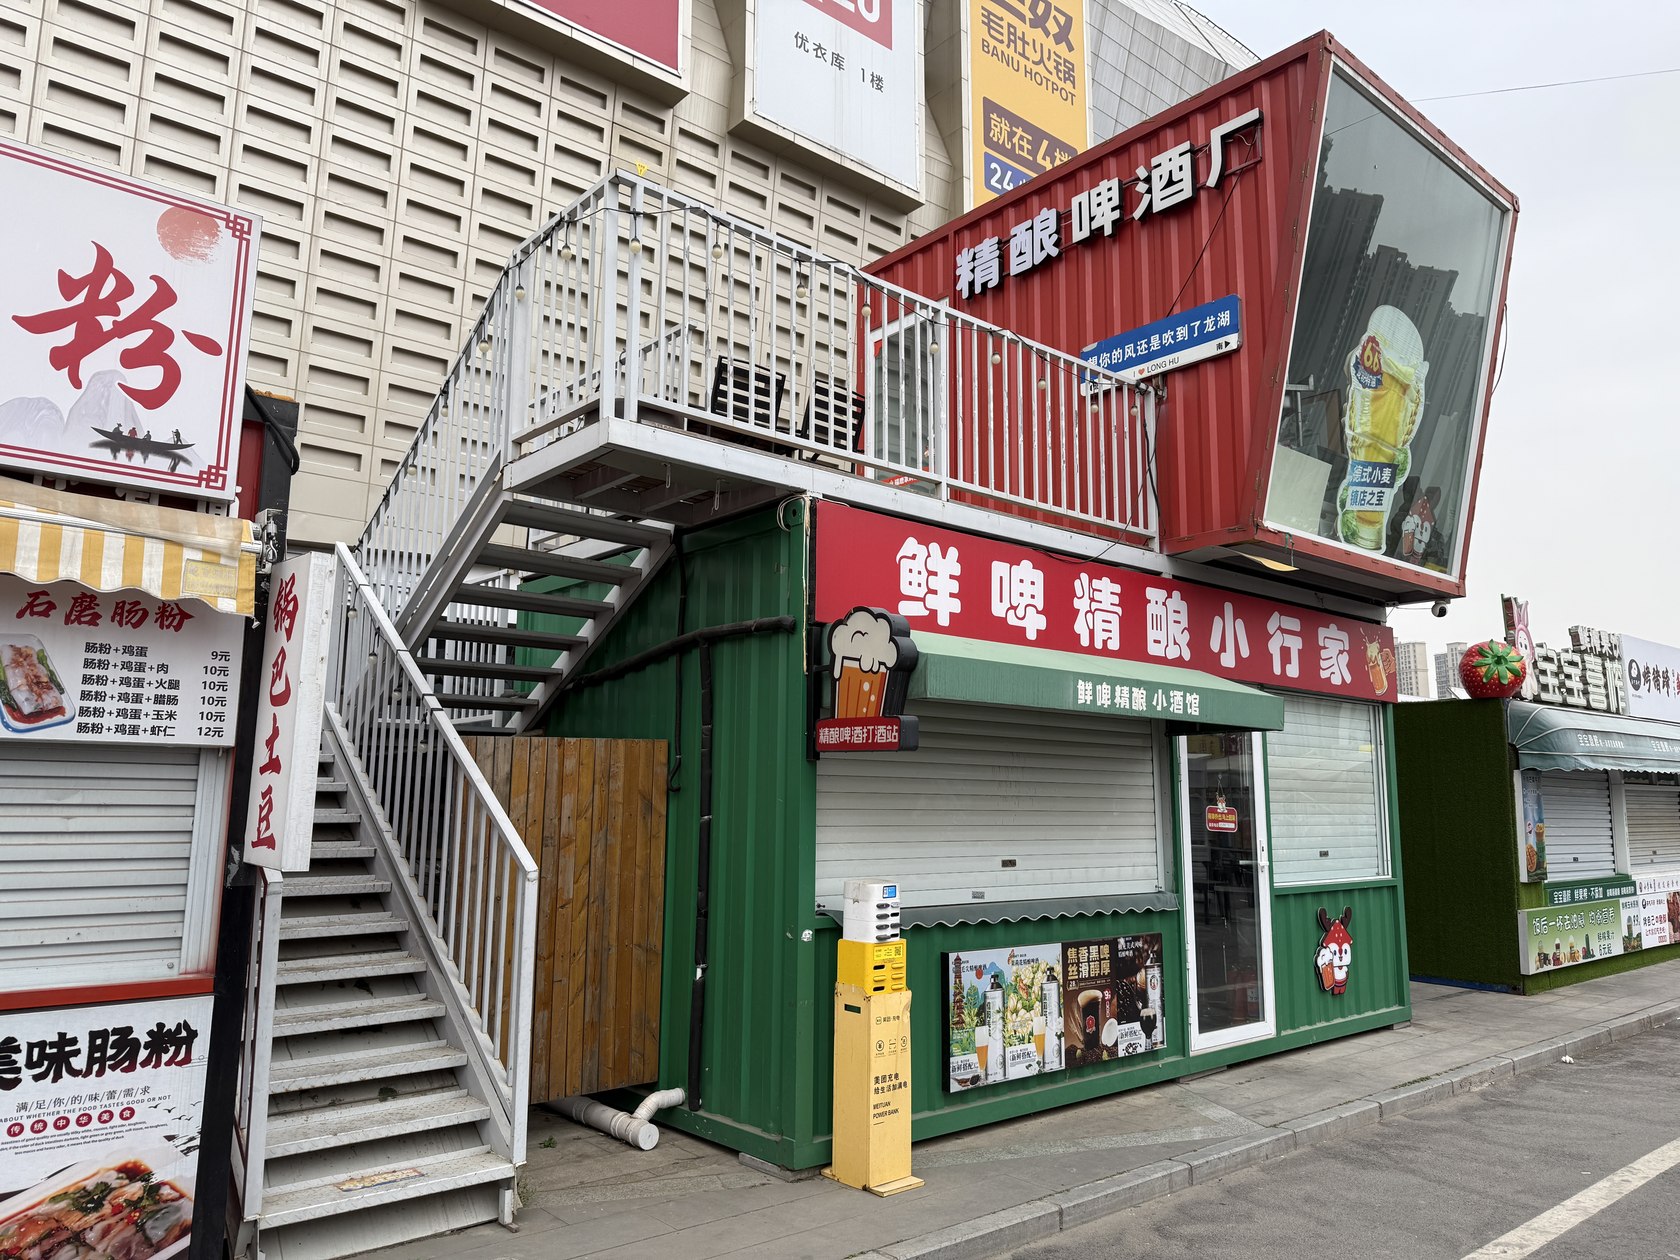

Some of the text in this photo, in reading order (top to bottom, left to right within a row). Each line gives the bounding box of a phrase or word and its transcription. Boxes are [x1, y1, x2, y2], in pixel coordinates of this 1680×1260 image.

[991, 0, 1075, 53] 奴
[981, 5, 1077, 90] 毛肚火锅
[793, 31, 885, 93] 优衣库 1楼
[981, 40, 1077, 106] BANU HOTPOT
[956, 107, 1264, 300] 精酿啤酒厂
[12, 240, 223, 410] 粉
[1147, 359, 1167, 374] LONG
[1168, 356, 1180, 366] HU
[16, 590, 195, 632] 石磨肠粉
[896, 536, 1353, 686] 鲜啤精酿小行家
[84, 641, 231, 662] 肠粉+鸡蛋 9元
[82, 657, 230, 677] 肠粉+鸡蛋+肉 10元
[81, 673, 228, 692] 肠粉+鸡蛋+火腿 10元
[79, 689, 227, 708] 肠粉+鸡蛋+腊肠 10元
[77, 705, 226, 723] 肠粉+鸡蛋+玉米 10元
[251, 572, 299, 851] 锅巴土豆
[76, 721, 224, 738] 肠粉+鸡蛋+虾仁 12元
[818, 724, 899, 744] 精酿啤酒打酒站
[1067, 943, 1110, 964] 焦香黑啤
[1067, 959, 1111, 980] 丝滑醇厚
[26, 1110, 60, 1120] WHETHER
[62, 1107, 76, 1115] THE
[78, 1104, 98, 1112] FOOD
[99, 1101, 125, 1110] TASTES
[126, 1098, 145, 1106] GOOD
